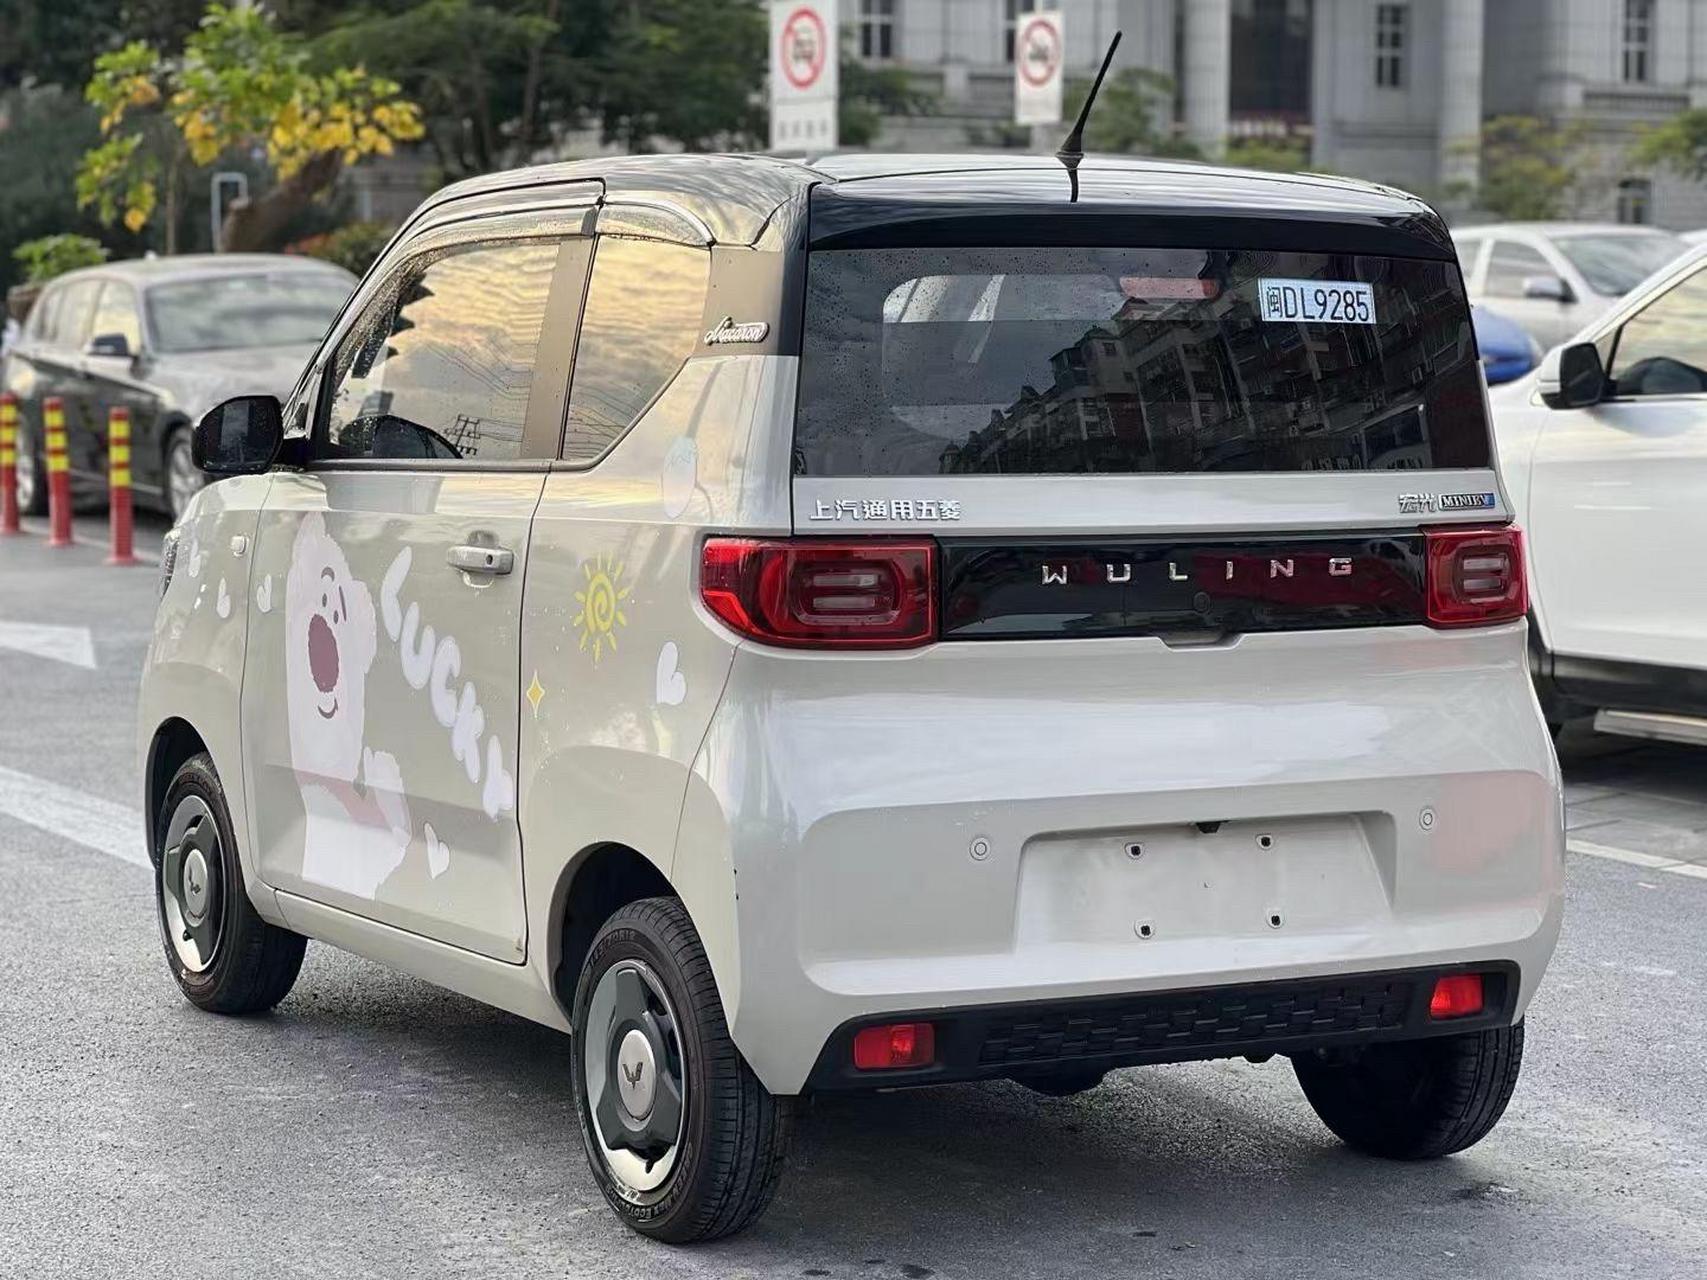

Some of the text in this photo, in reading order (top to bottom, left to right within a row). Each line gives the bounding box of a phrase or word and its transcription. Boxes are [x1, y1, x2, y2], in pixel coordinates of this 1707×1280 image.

[1266, 286, 1370, 322] 闽DL9285
[810, 499, 961, 521] 上汽通用五菱
[1041, 556, 1353, 586] WULING
